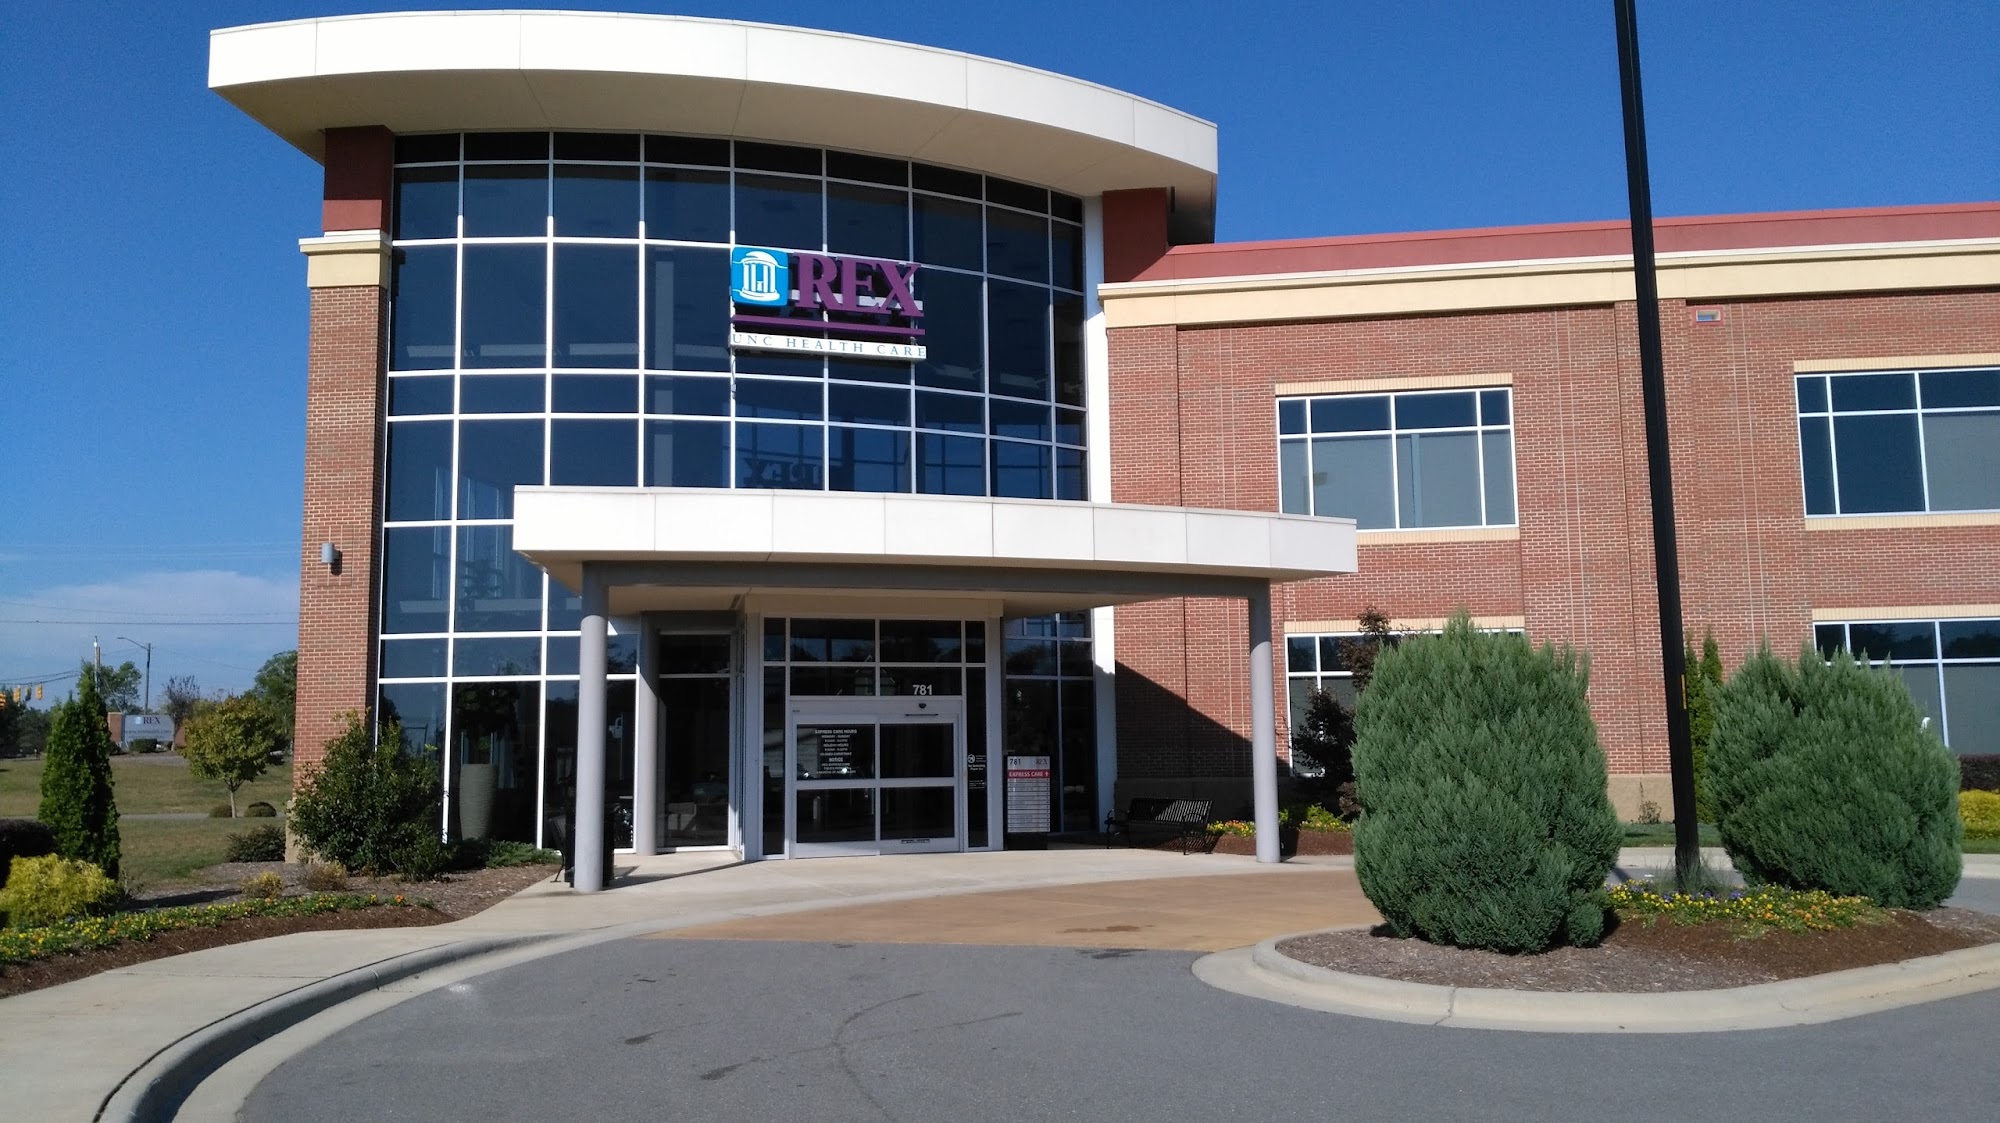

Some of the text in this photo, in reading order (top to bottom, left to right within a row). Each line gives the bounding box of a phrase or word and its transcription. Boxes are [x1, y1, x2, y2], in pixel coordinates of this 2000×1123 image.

[793, 252, 924, 317] REX
[732, 333, 926, 357] UNC HEALTH CARE
[912, 684, 933, 696] 781
[1009, 758, 1021, 766] 781
